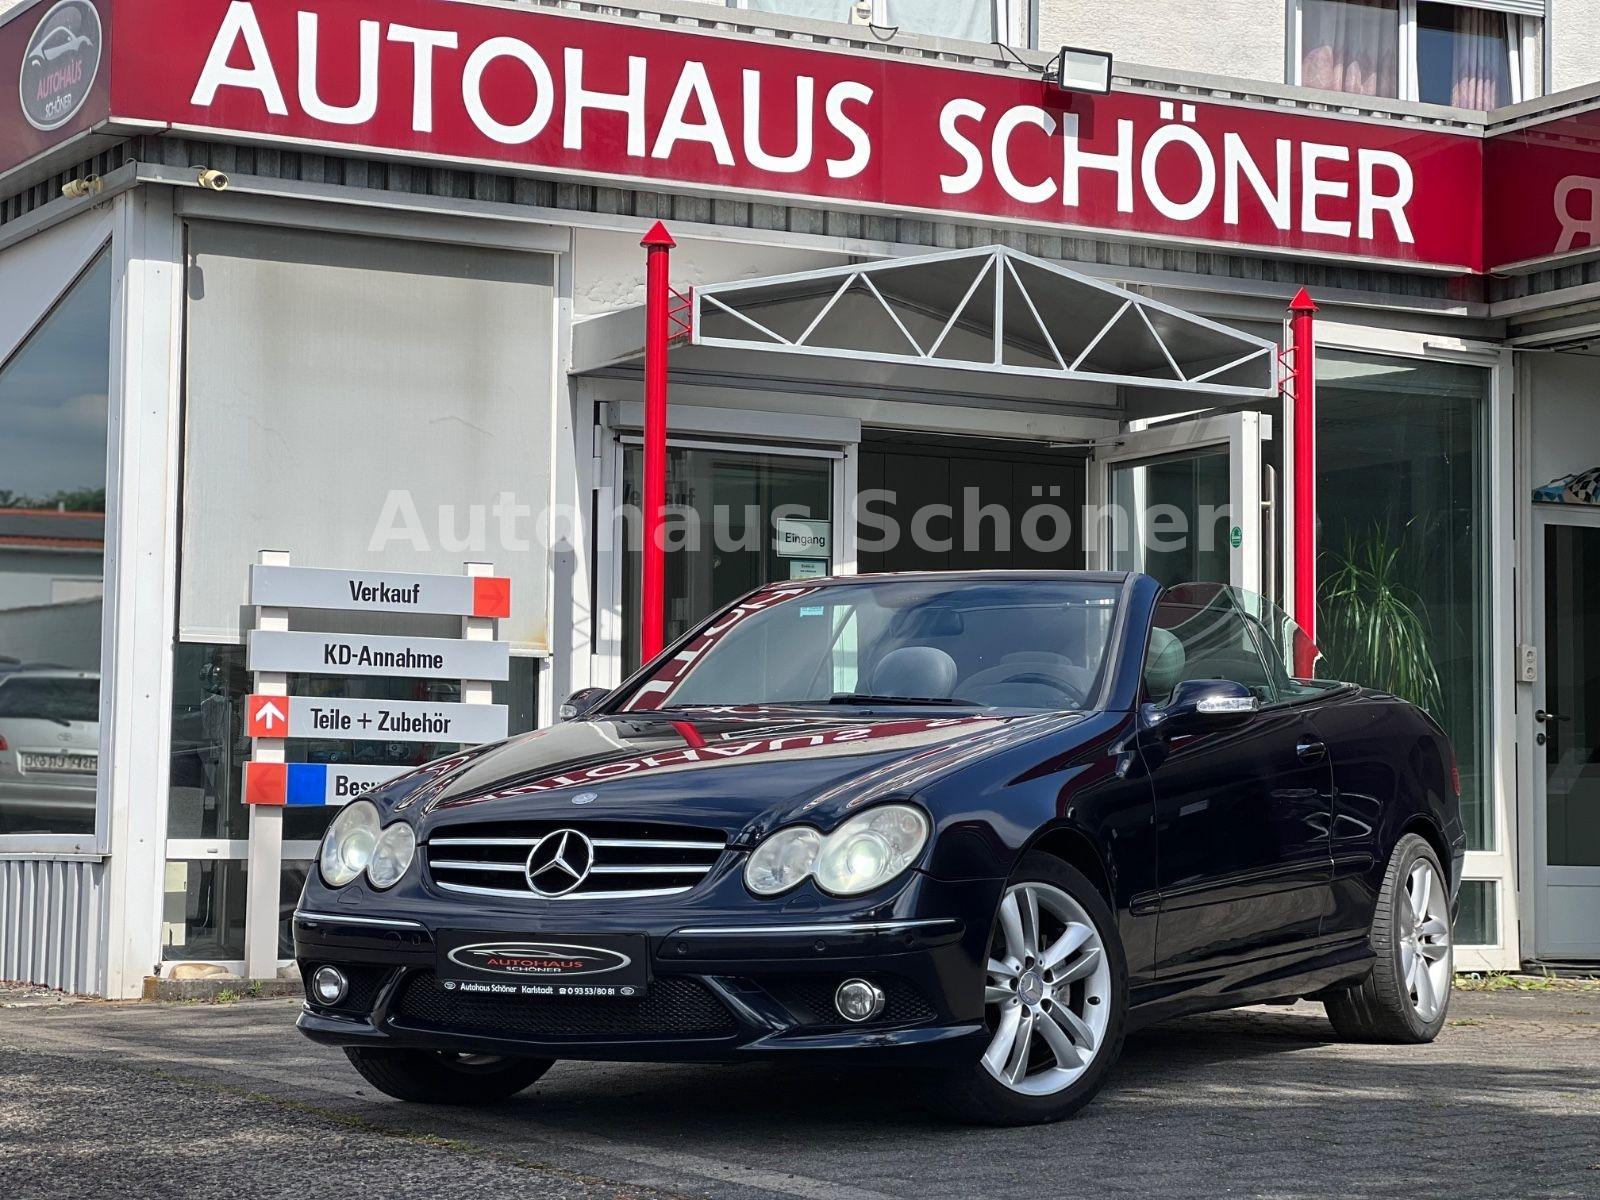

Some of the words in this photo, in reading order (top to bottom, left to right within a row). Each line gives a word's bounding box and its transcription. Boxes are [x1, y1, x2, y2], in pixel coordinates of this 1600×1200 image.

[37, 60, 82, 101] AUTOHAUS
[45, 93, 73, 118] SCHÖNER
[190, 0, 873, 179] AUTOHAUS
[939, 98, 1415, 244] SCHÖNER
[785, 532, 826, 547] Eingang
[349, 580, 420, 604] Verkauf
[324, 644, 443, 669] KD-Annahme
[310, 708, 351, 730] Teile
[378, 711, 451, 734] Zubehör
[335, 775, 380, 796] Bes
[487, 958, 584, 968] AUTOHAUS
[506, 965, 562, 973] SCHÖNER
[460, 983, 490, 992] Autohaus
[491, 984, 517, 993] Schöner
[521, 985, 553, 994] Karlstadt
